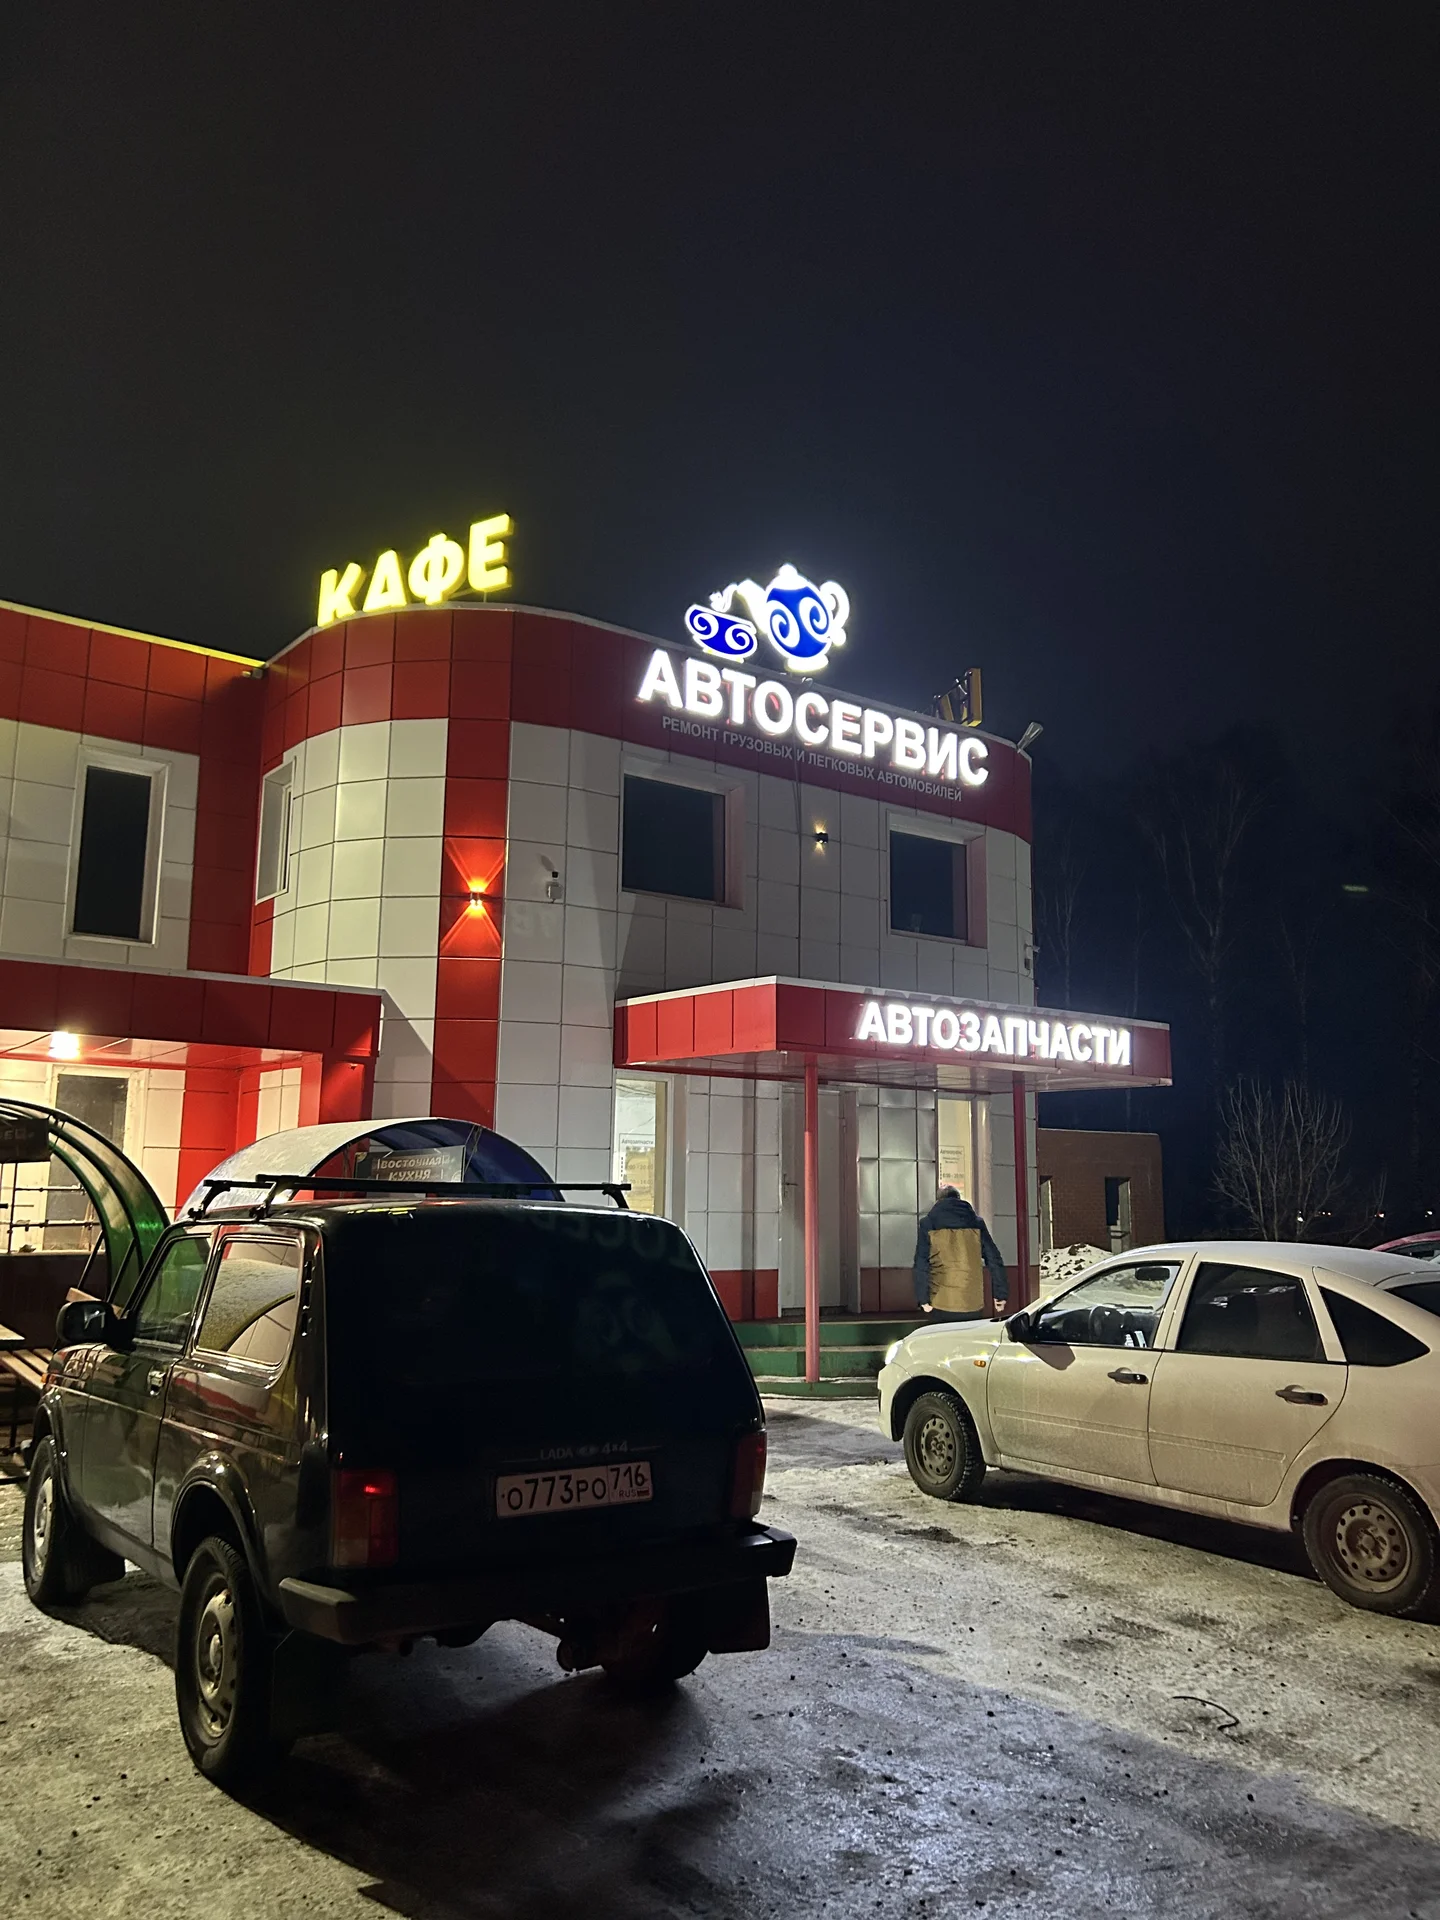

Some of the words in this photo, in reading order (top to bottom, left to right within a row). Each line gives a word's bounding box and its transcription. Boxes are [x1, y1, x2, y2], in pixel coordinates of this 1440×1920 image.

[317, 513, 513, 627] КАФЕ
[637, 648, 990, 787] АВТОСЕРВИС
[661, 715, 719, 742] РЕМОНТ
[722, 730, 793, 760] ГРУЗОВЫХ
[797, 748, 806, 762] И
[808, 752, 876, 780] ЛЕГКОВЫХ
[877, 769, 962, 802] АВТОМОБИЛЕЙ
[855, 1000, 1131, 1067] АВТОЗАПЧАСТИ
[380, 1156, 442, 1169] ВОСТОЧНАЯ
[388, 1169, 432, 1181] КУХНЯ
[540, 1449, 574, 1461] LADA
[619, 1490, 637, 1498] RUS
